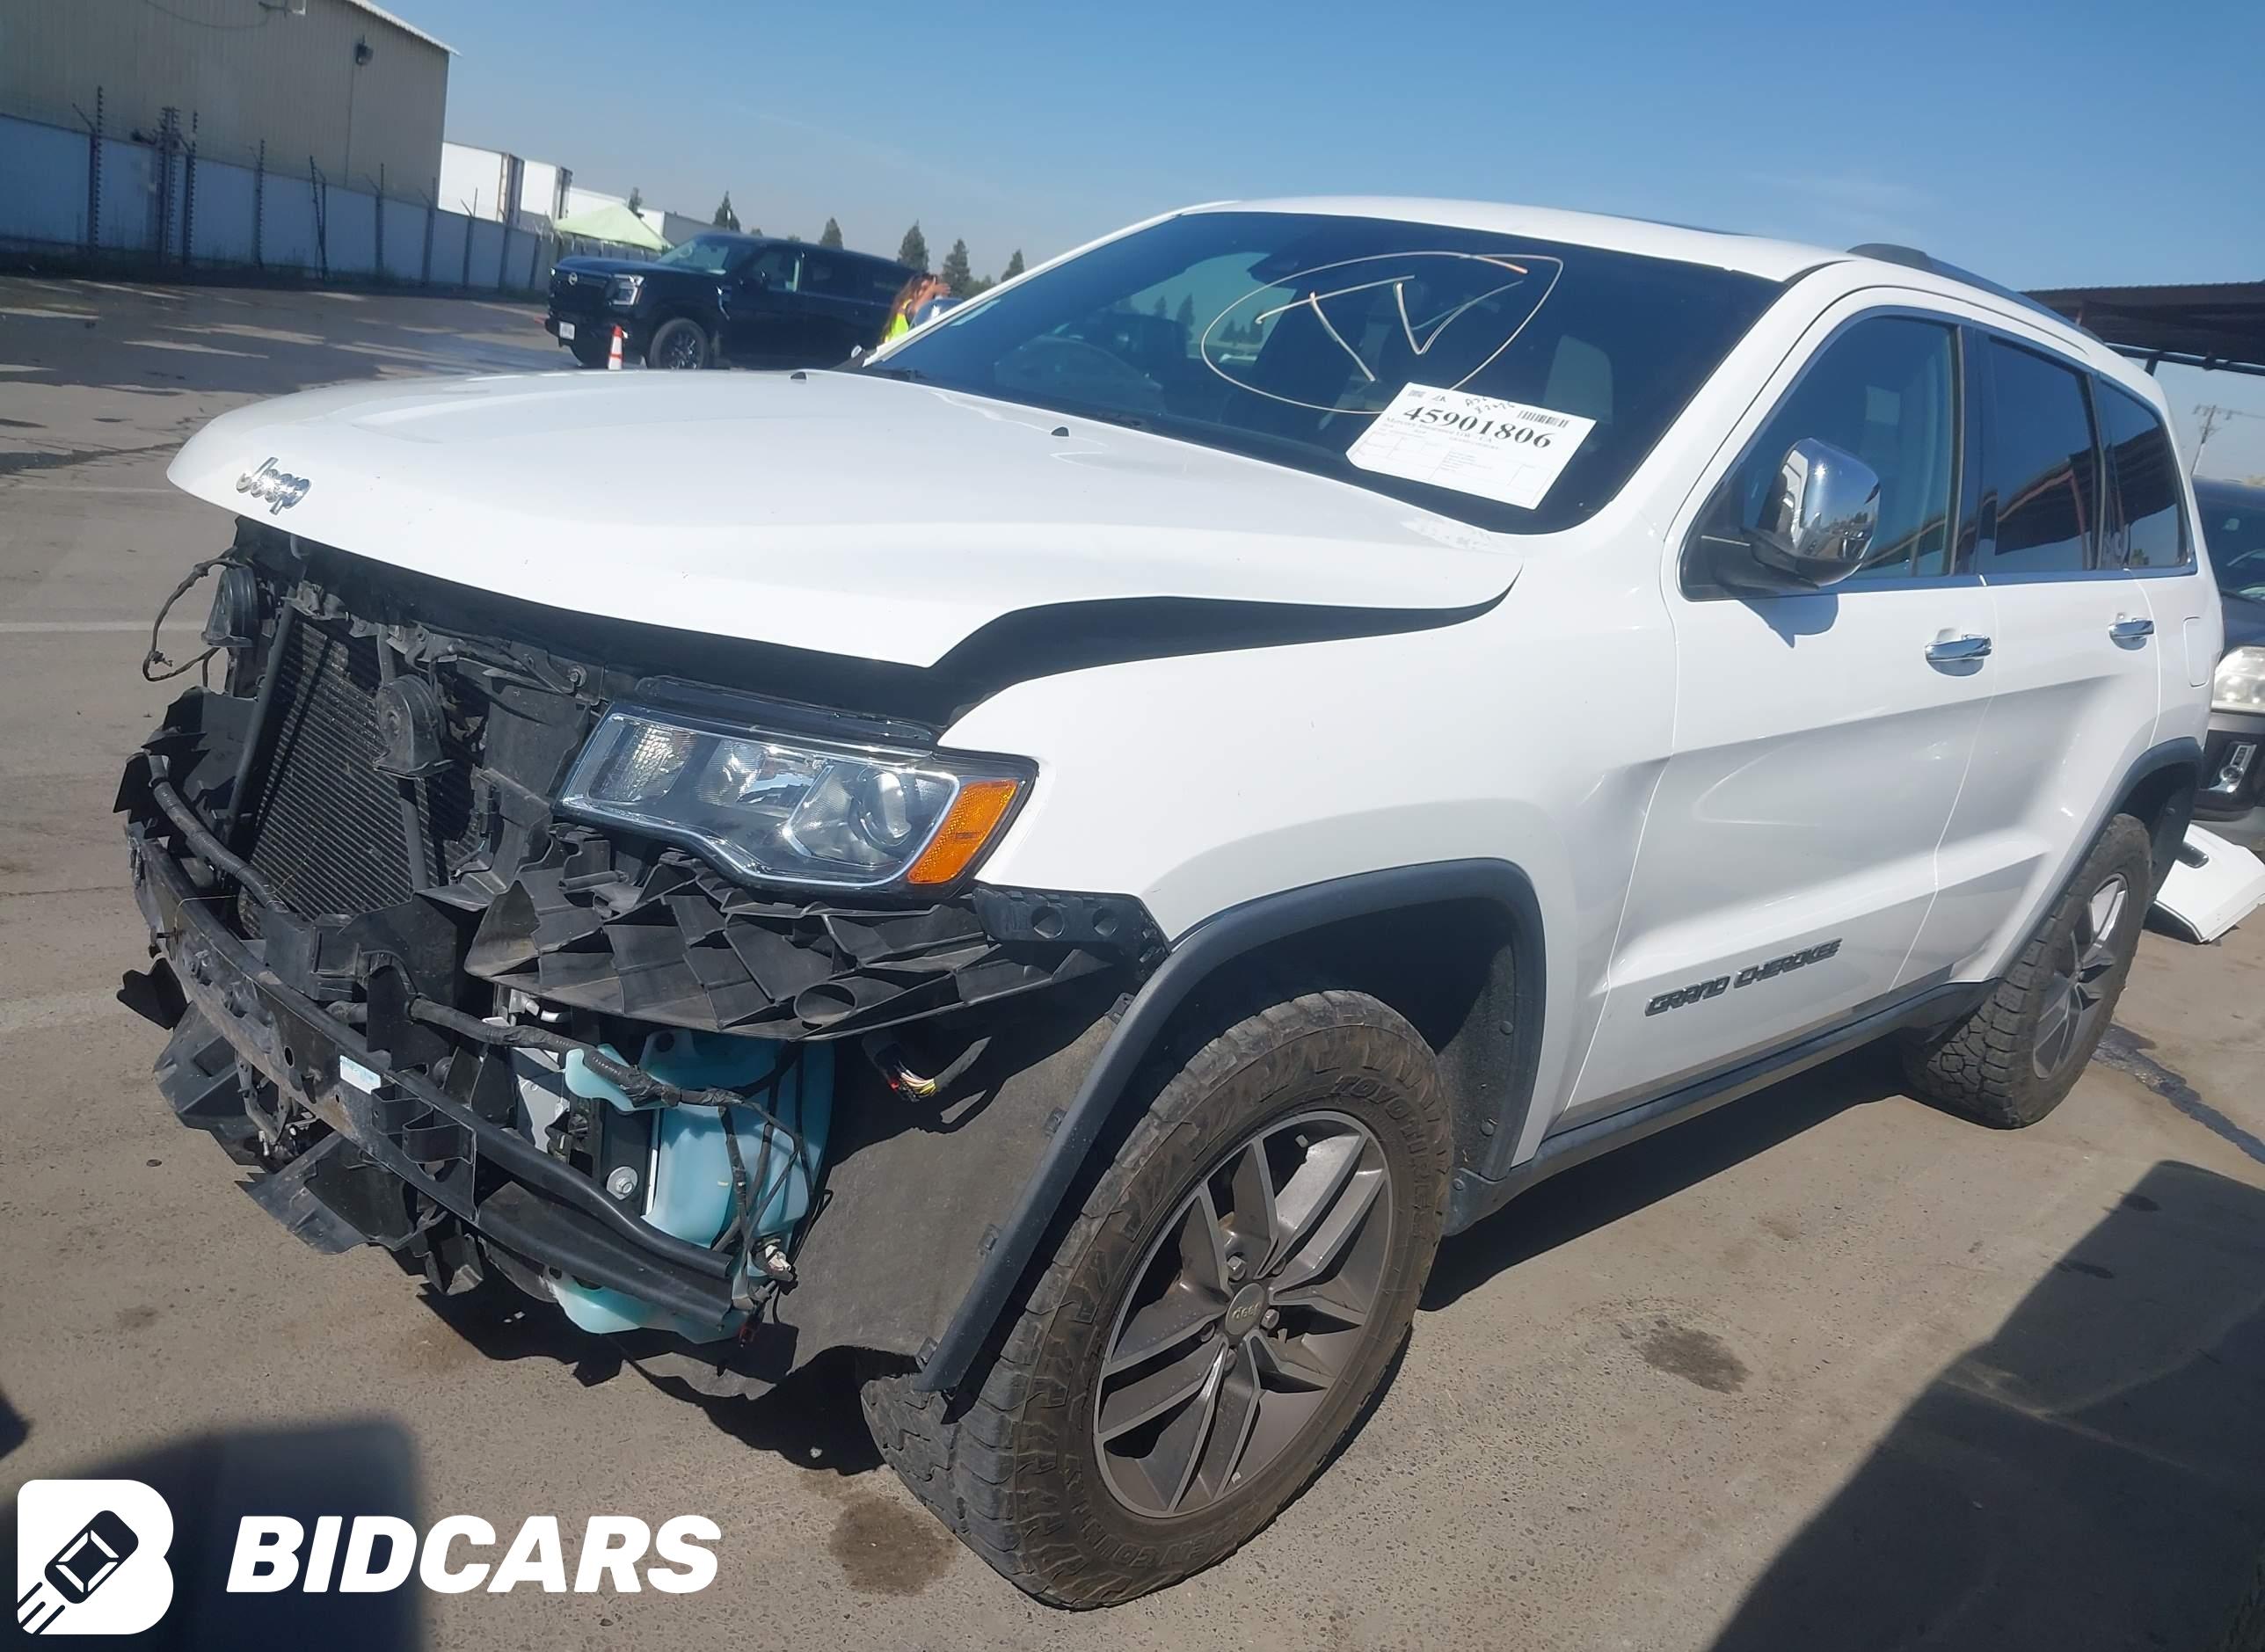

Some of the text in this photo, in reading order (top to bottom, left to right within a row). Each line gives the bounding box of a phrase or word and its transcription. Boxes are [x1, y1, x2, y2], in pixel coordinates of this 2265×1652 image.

[1404, 405, 1555, 448] 45901806
[236, 457, 311, 515] Jeep
[1645, 937, 1843, 1017] GRAND CHEROKEE
[1329, 1074, 1413, 1123] TOYO
